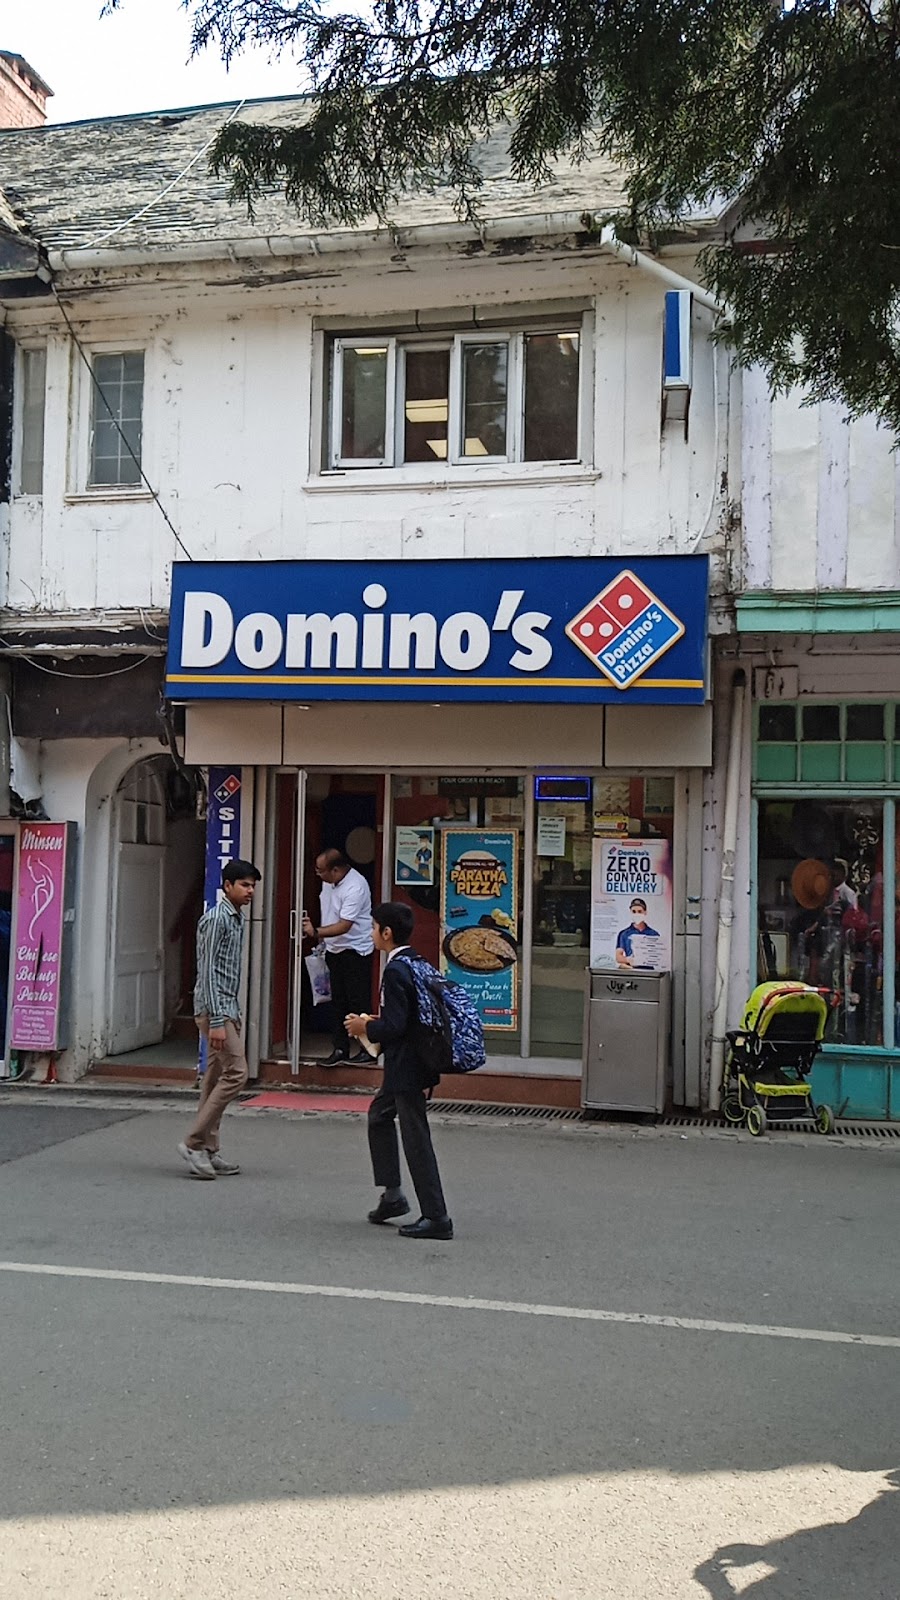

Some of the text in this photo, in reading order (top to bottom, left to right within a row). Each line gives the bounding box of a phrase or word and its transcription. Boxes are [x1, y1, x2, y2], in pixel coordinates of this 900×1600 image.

[181, 583, 553, 671] Domino's
[602, 611, 662, 667] Domino's
[613, 641, 655, 679] Pizza
[21, 829, 62, 851] Minsen
[607, 856, 651, 872] ZERO
[450, 869, 508, 884] PARATHA
[606, 873, 657, 883] CONTACT
[456, 881, 501, 897] PIZZA
[606, 883, 657, 893] DELIVERY
[17, 945, 58, 962] Chiese
[17, 985, 53, 1002] Parlor
